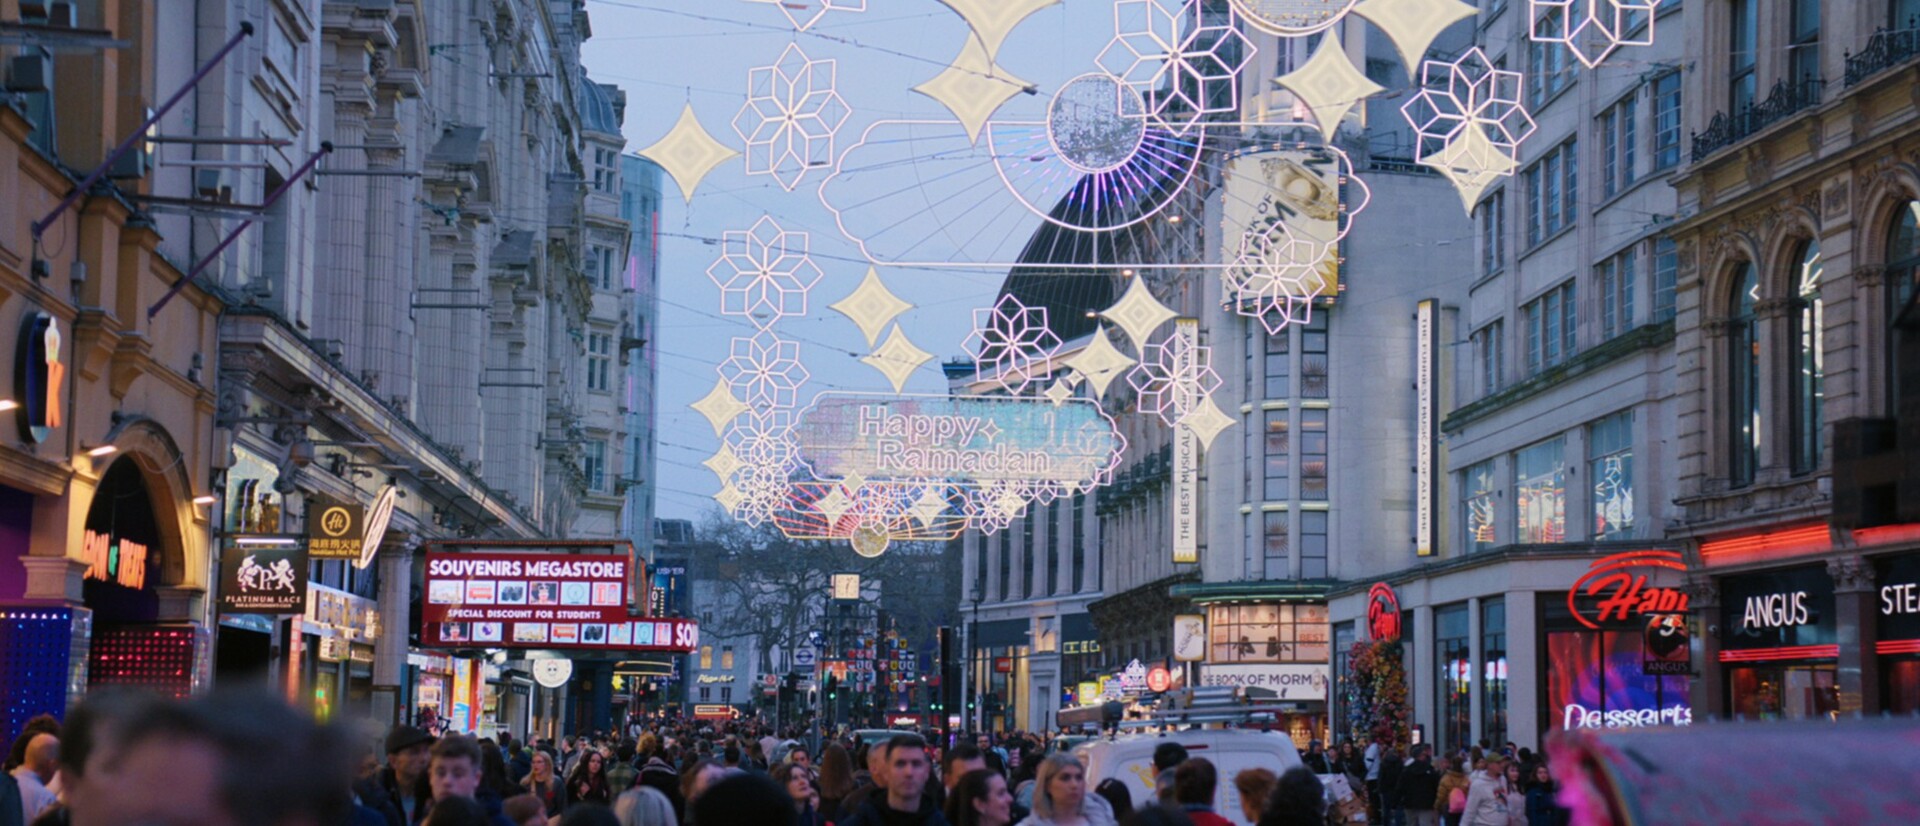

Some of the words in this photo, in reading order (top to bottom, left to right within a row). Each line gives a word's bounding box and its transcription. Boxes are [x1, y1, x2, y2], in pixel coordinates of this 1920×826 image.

[1257, 192, 1272, 214] OF
[859, 405, 981, 447] Happy
[877, 438, 1051, 473] Ramadan
[1181, 433, 1191, 483] MUSICAL
[1180, 486, 1190, 515] BEST
[1180, 518, 1190, 540] THE
[429, 559, 522, 576] SOUVENIRS
[525, 561, 624, 578] MEGASTORE
[225, 595, 274, 603] PLATINUM
[278, 595, 301, 603] LACE
[1743, 591, 1808, 628] ANGUS
[1881, 583, 1920, 615] STE
[447, 609, 484, 618] SPECIAL
[486, 610, 533, 618] DISCOUNT
[535, 610, 554, 619] FOR
[556, 610, 602, 619] STUDENTS
[1648, 661, 1688, 672] ANGUS
[1216, 674, 1246, 685] BOOK
[1247, 674, 1266, 685] OF
[1269, 674, 1328, 685] MORMN
